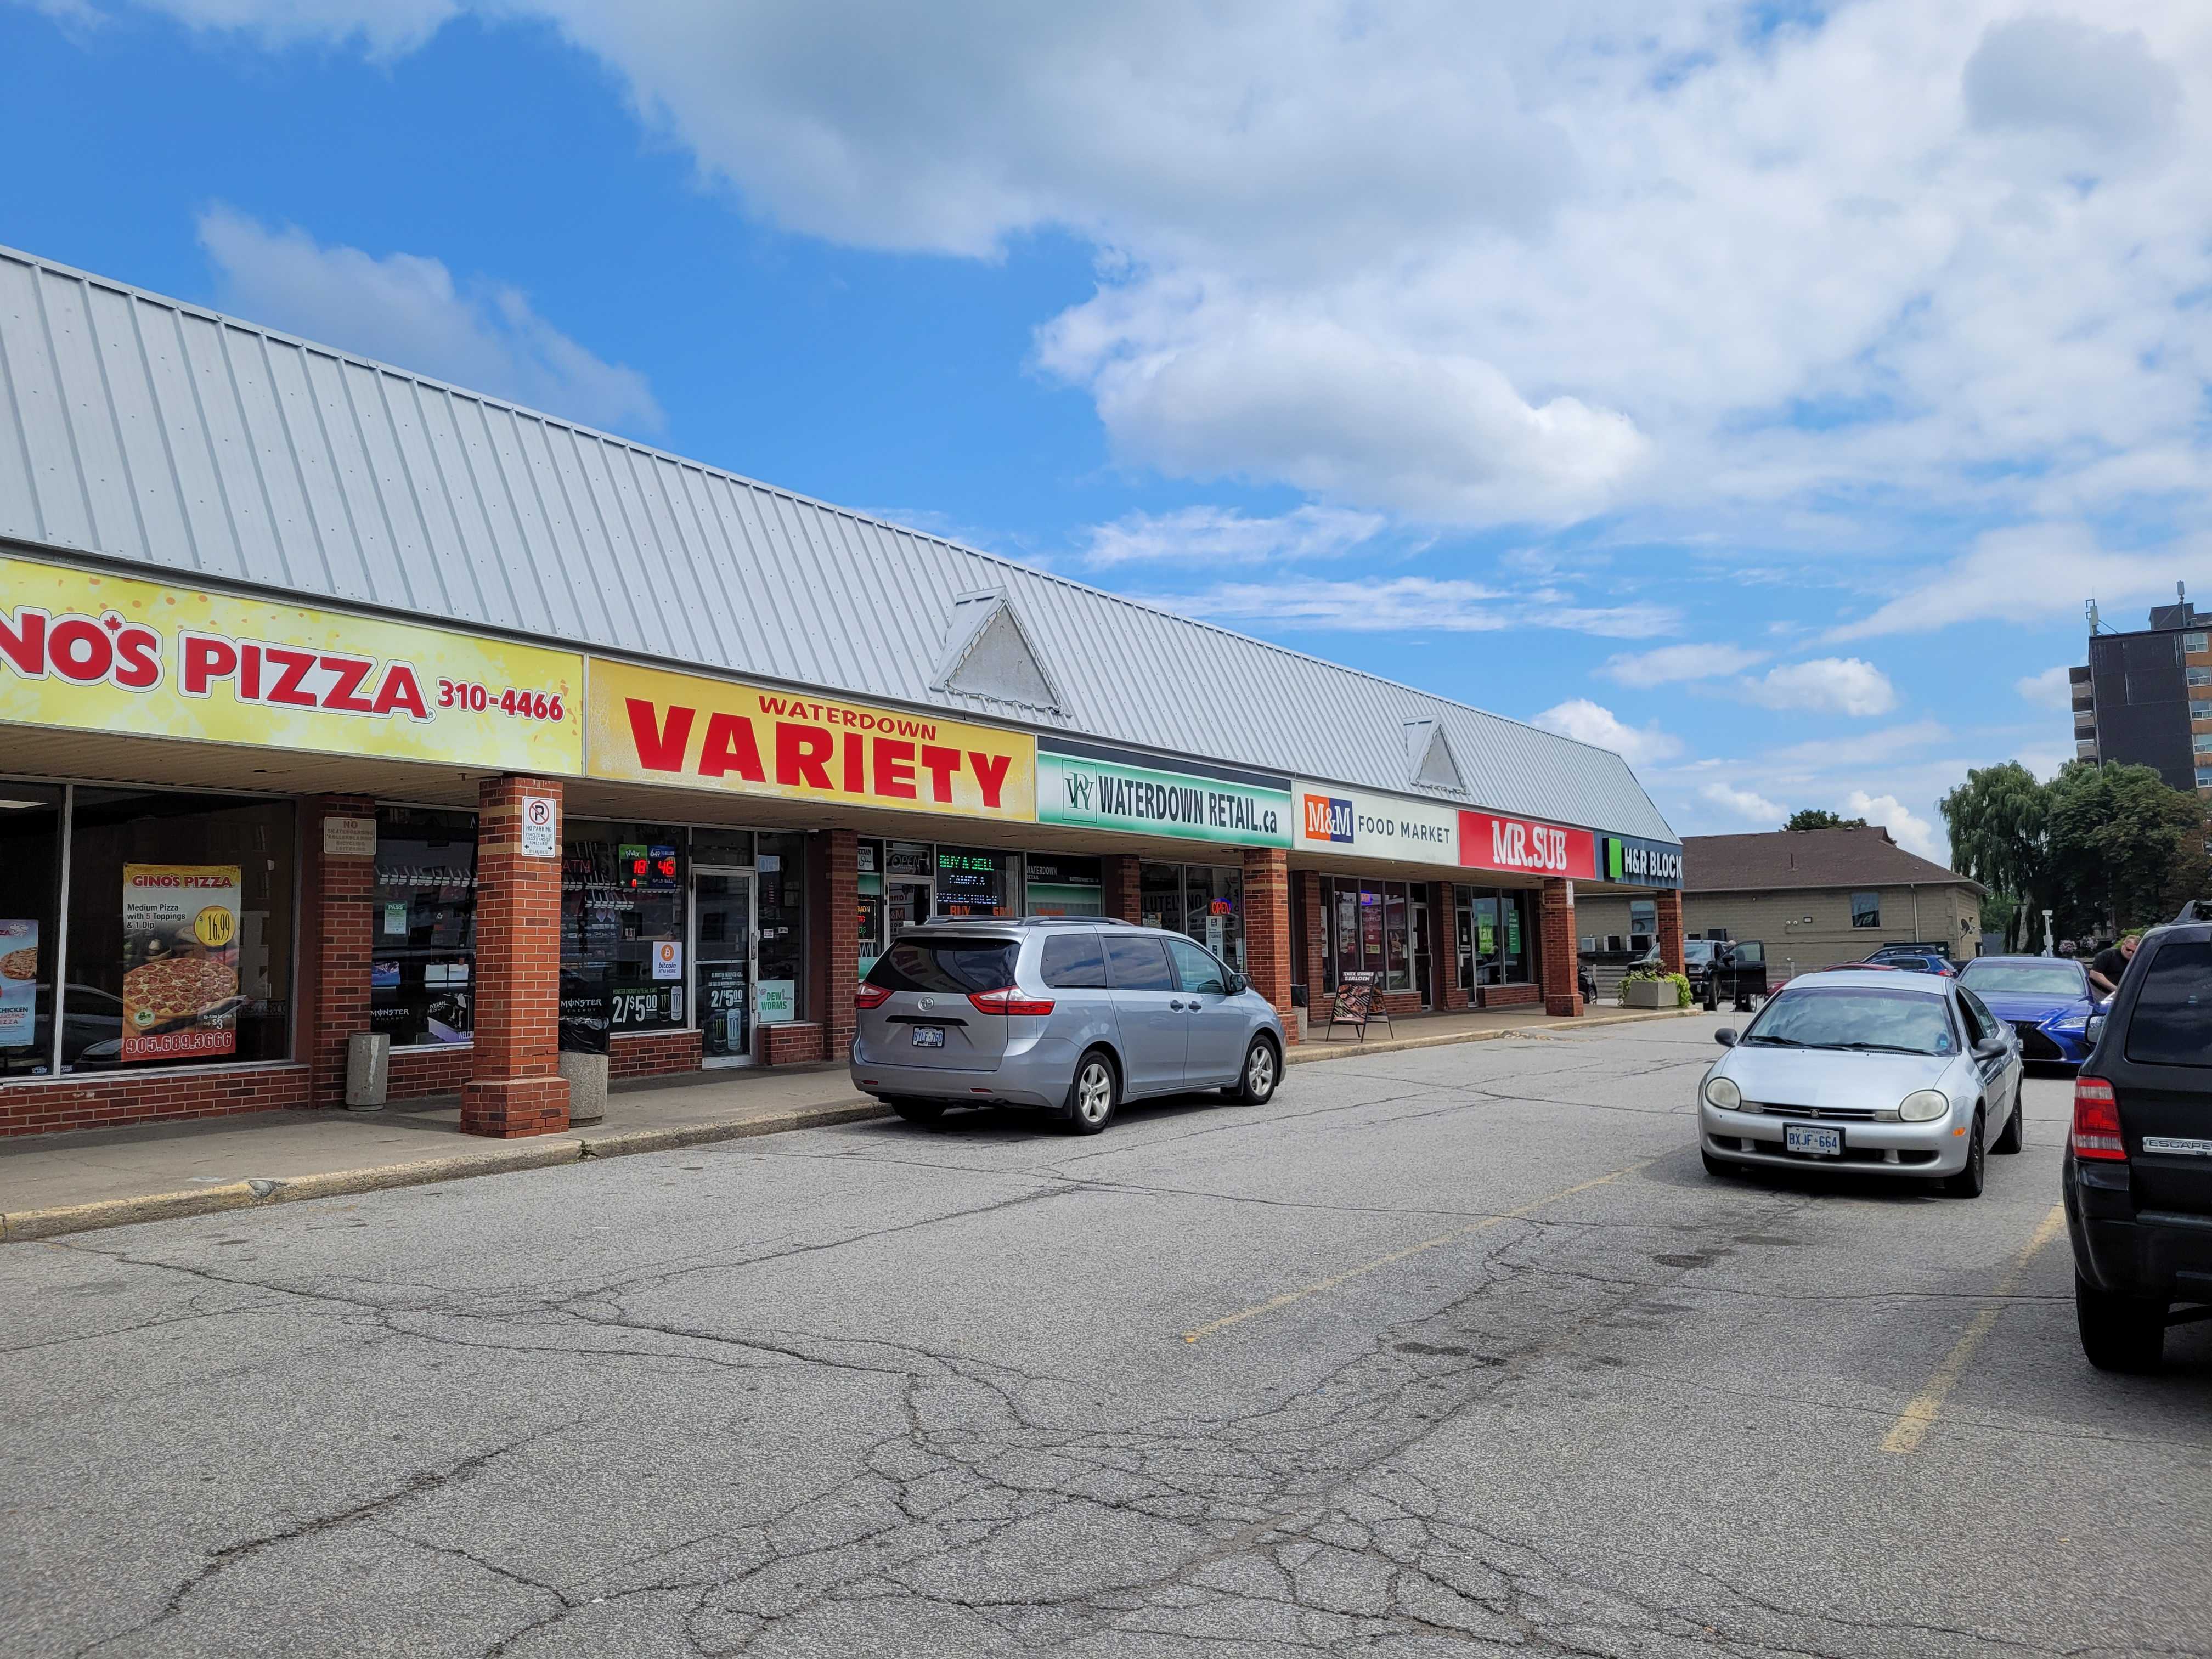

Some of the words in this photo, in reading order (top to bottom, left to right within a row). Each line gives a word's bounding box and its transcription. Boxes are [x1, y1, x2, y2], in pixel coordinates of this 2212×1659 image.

[185, 636, 428, 719] PIZZA
[438, 680, 563, 721] 310-4466
[758, 695, 936, 742] WATERDOWN
[625, 697, 1012, 809] VARIETY
[1098, 775, 1204, 825] WATERDOWN
[1209, 792, 1277, 834] RETAIL.ca
[1307, 802, 1352, 837] M&M
[1358, 815, 1394, 836] FOOD
[1401, 821, 1450, 844] MARKET
[562, 860, 590, 873] ATM
[633, 860, 646, 874] 18
[892, 855, 921, 872] OPEN
[940, 855, 960, 868] BUY
[972, 857, 995, 871] SELL
[1624, 847, 1647, 875] H&R
[1650, 851, 1683, 879] BLOCK
[132, 874, 180, 887] GINO'S
[184, 876, 233, 887] PIZZA
[1211, 902, 1230, 914] OPEN
[153, 912, 185, 921] Toppings
[767, 991, 782, 1001] DEW
[561, 998, 602, 1008] MONSTER
[761, 1001, 787, 1010] WORMS
[370, 1008, 409, 1017] MONSTER
[212, 1019, 223, 1029] $3
[126, 1032, 232, 1053] 905.689.3666
[932, 1032, 943, 1042] 760
[1789, 1133, 1813, 1146] BXJF
[1819, 1136, 1837, 1148] 664
[2149, 1139, 2211, 1150] ESCAPE
